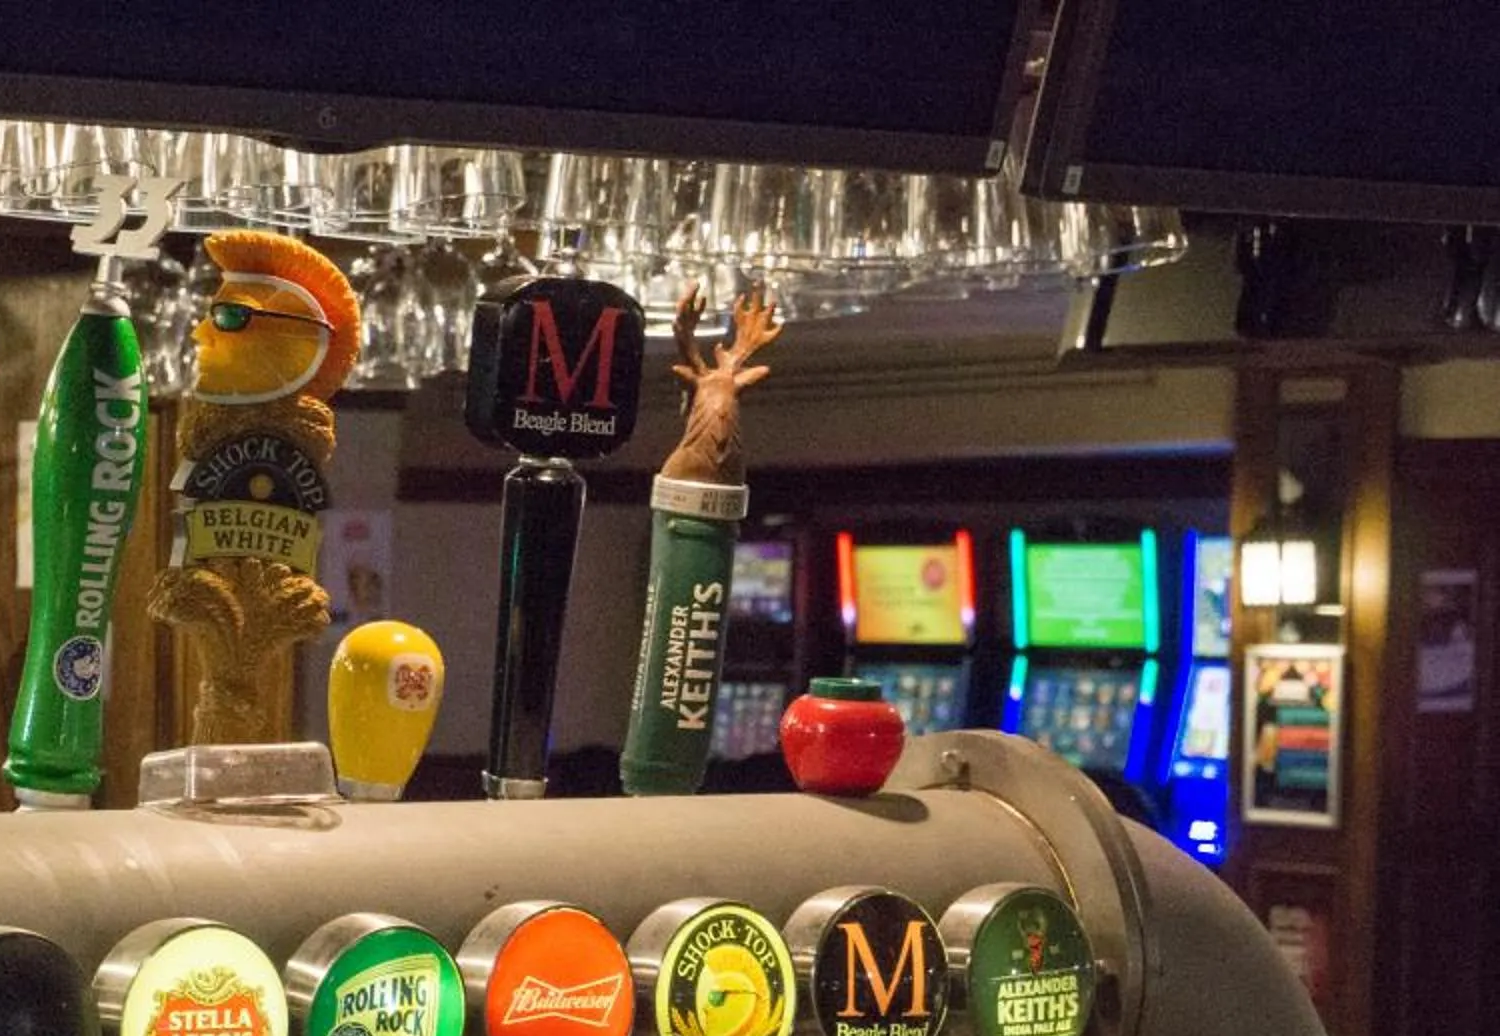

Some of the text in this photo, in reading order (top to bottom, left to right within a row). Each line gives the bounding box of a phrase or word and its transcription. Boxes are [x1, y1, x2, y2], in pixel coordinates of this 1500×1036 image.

[516, 296, 626, 409] M
[92, 366, 143, 493] ROCK
[512, 408, 617, 436] Beagle Blend
[195, 436, 325, 508] SHOCK TOP
[203, 507, 310, 540] BELGIAN
[213, 530, 295, 557] WHITE
[76, 500, 127, 630] ROLLING
[660, 604, 690, 711] ALEXANDER
[676, 580, 724, 732] KEITH'S
[677, 919, 776, 980] SHOCK TOP
[835, 920, 932, 1018] M
[341, 975, 427, 1018] ROLLING
[513, 985, 614, 1013] Budweiser
[997, 975, 1078, 999] ALEXANDER
[997, 992, 1079, 1025] KEITH'S
[168, 1007, 253, 1031] STELLA
[1003, 1018, 1072, 1036] INDIA PALE ALE
